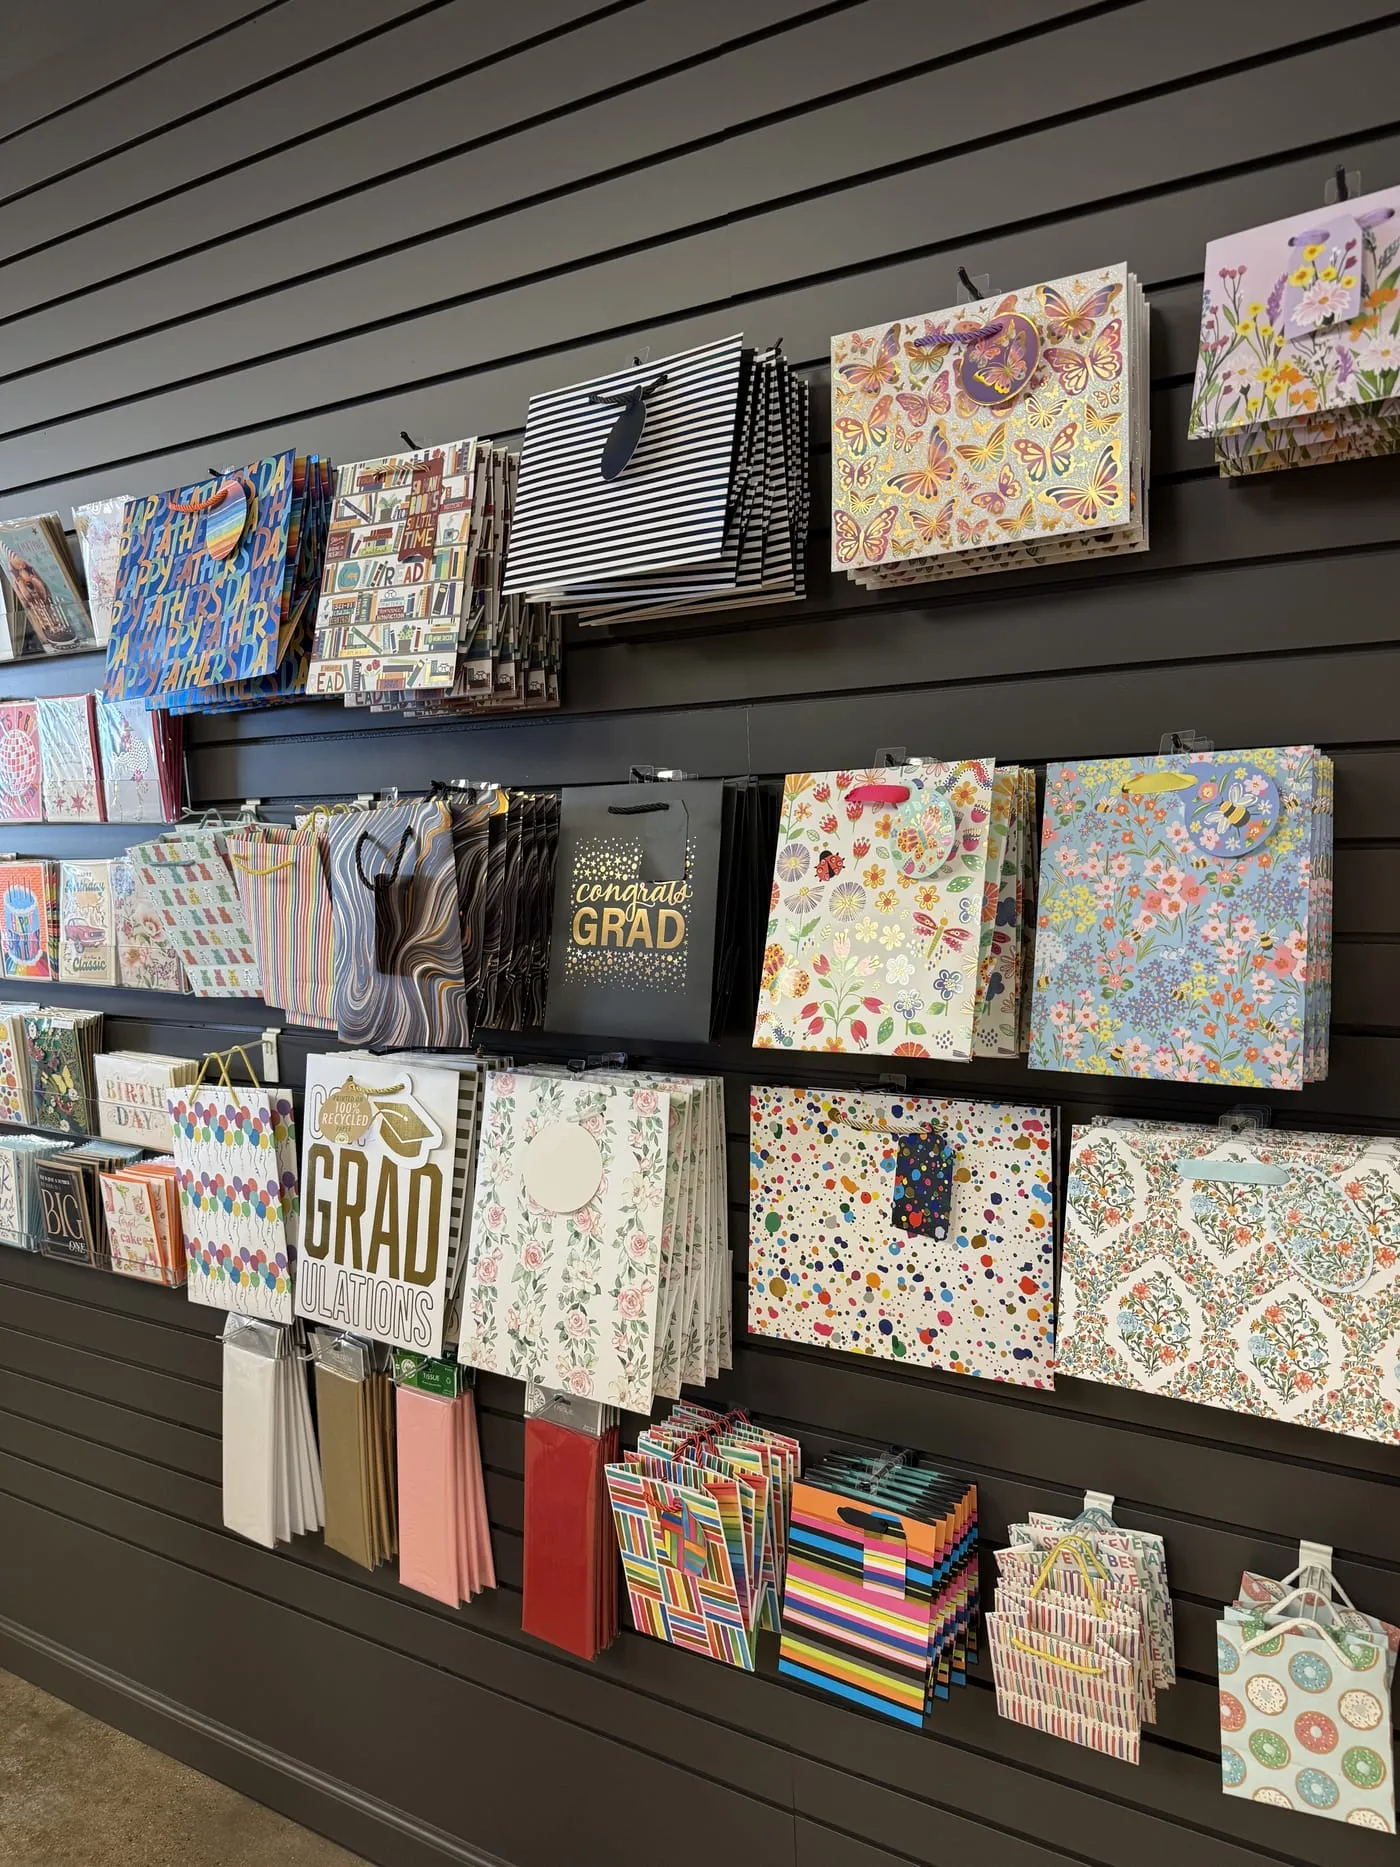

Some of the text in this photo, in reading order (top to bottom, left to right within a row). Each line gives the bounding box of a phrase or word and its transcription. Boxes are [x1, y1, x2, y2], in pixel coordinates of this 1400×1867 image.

[404, 528, 434, 550] TIME
[576, 880, 693, 922] congrats
[572, 907, 686, 949] GRAD
[73, 957, 107, 972] Classic
[107, 1079, 164, 1108] BIRTH
[116, 1106, 153, 1131] DAY
[321, 1113, 369, 1126] RECYCLED
[335, 1102, 360, 1114] 100%
[41, 1188, 85, 1240] BIG
[304, 1143, 443, 1287] GRAD
[68, 1240, 86, 1254] ONE
[302, 1260, 433, 1347] ULATIONS
[423, 1372, 441, 1382] TISSUE
